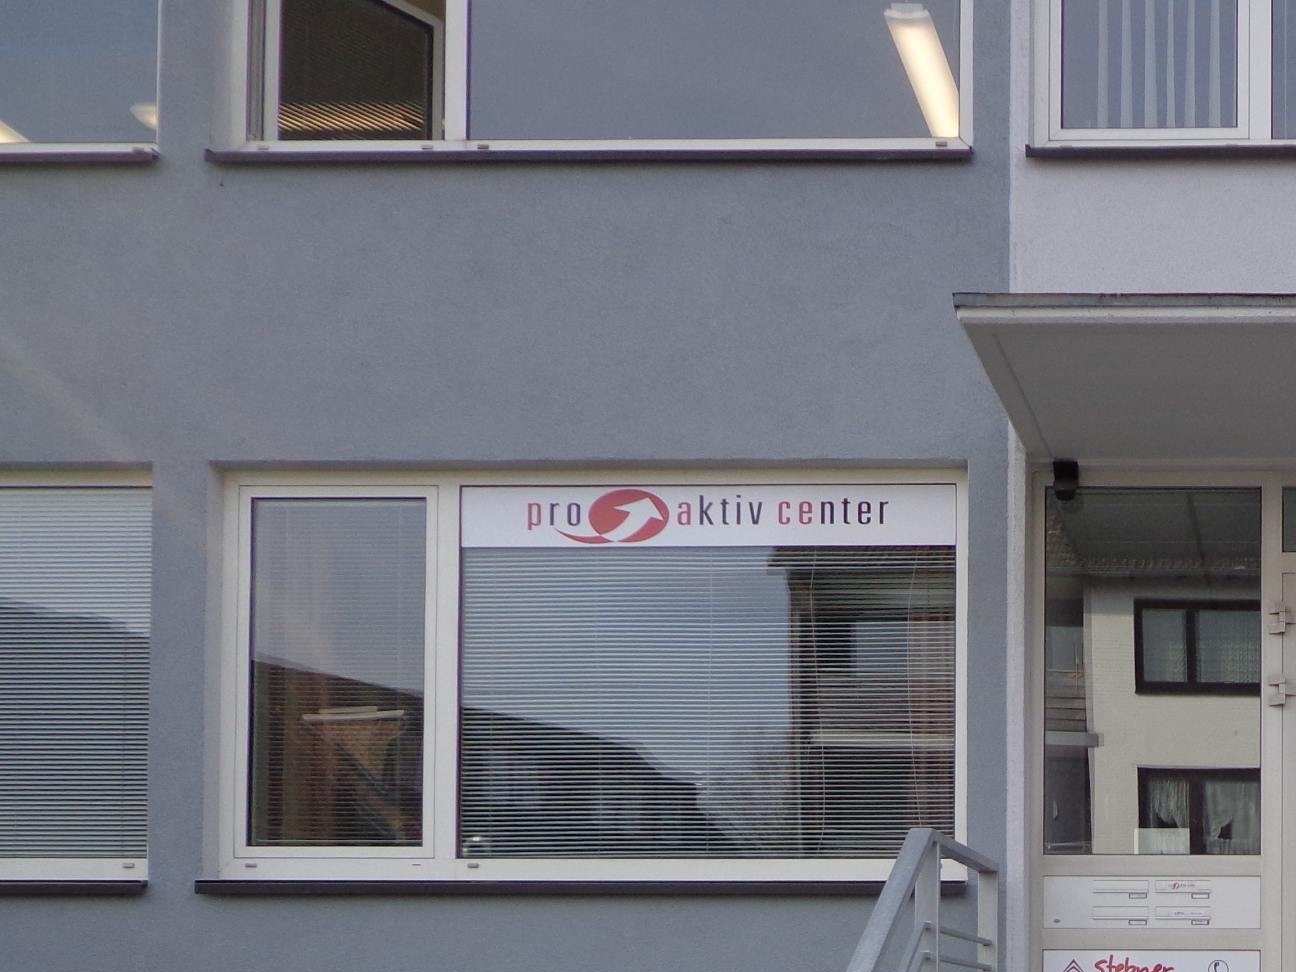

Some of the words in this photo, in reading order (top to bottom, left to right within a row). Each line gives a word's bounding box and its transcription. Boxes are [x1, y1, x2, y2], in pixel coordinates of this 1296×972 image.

[528, 500, 582, 531] pro
[677, 494, 763, 526] aktiv
[778, 498, 890, 525] center
